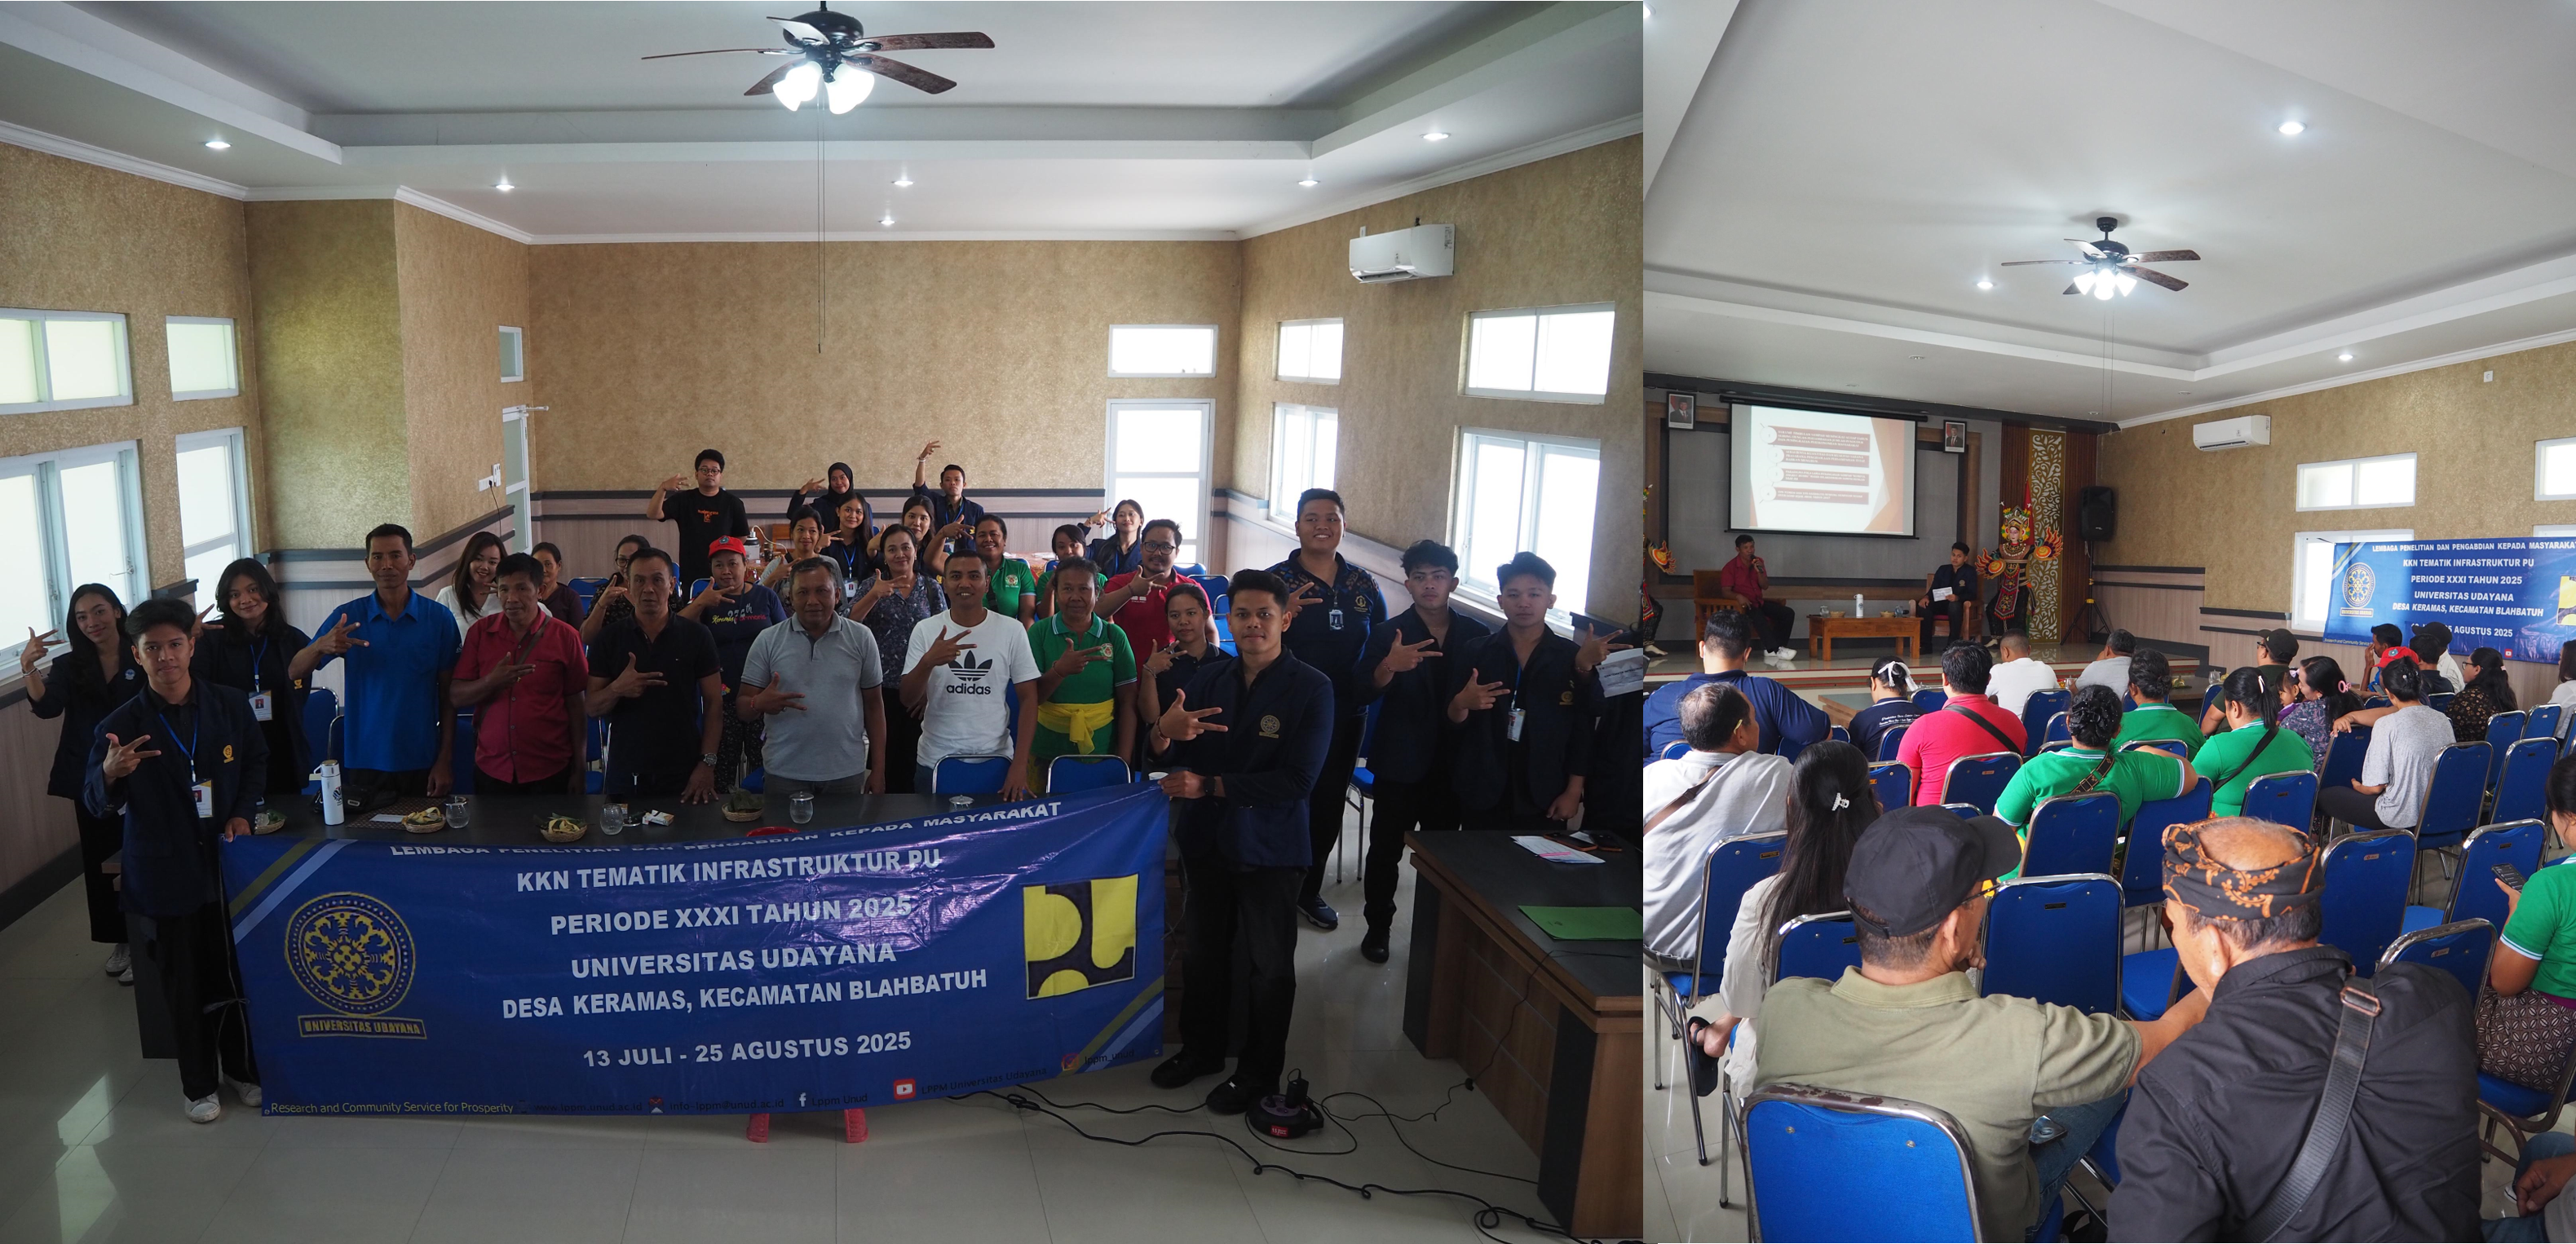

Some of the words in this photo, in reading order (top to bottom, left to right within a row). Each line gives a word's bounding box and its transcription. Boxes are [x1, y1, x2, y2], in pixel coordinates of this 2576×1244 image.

[2400, 544, 2434, 552] PENELITIAN
[2529, 541, 2576, 549] MASYARAKA
[2403, 558, 2418, 567] KKN
[2419, 558, 2451, 567] TEMATIK
[2453, 558, 2521, 567] INFRASTRUKTUR
[2522, 558, 2534, 567] PU
[2410, 576, 2445, 584] PERIODE
[2446, 576, 2466, 584] XXXI
[2468, 576, 2499, 585] TAHUN
[2500, 576, 2522, 585] 2025
[2414, 591, 2469, 600] UNIVERSITAS
[2471, 593, 2514, 602] UDAYANA
[2392, 602, 2410, 611] DESA
[2412, 603, 2447, 614] KERAMAS,
[2449, 605, 2494, 615] KECAMATAN
[2495, 607, 2544, 617] BLAHBATUH
[2454, 626, 2492, 636] AGUSTUS
[2494, 629, 2513, 637] 2025
[946, 683, 992, 695] adidas
[391, 845, 491, 856] LEMBAGA
[684, 834, 819, 850] PENGABDIAN
[829, 822, 913, 837] KEPADA
[923, 801, 1062, 827] MASYARAKAT
[517, 870, 569, 892] KKN
[577, 863, 686, 889] TEMATIK
[693, 850, 901, 881] INFRASTRUKTUR
[908, 849, 941, 871] PU
[550, 909, 669, 936] PERIODE
[675, 906, 739, 929] XXXI
[749, 900, 841, 925] TAHUN
[847, 894, 913, 920] 2025
[571, 951, 754, 978] UNIVERSITAS
[761, 942, 896, 968] UDAYANA
[503, 997, 563, 1019] DESA
[573, 989, 693, 1015] KERAMAS,
[700, 982, 842, 1009] KECAMATAN
[849, 968, 988, 1001] BLAHBATUH
[304, 1020, 372, 1033] UNIVERSITAS
[582, 1049, 611, 1067] 13
[618, 1046, 673, 1065] JULI
[695, 1043, 723, 1063] 25
[731, 1037, 850, 1061] AGUSTUS
[856, 1030, 912, 1055] 2025
[1085, 1049, 1135, 1065] lppm_unud
[921, 1083, 948, 1095] LPPM
[950, 1074, 1003, 1090] Universitas
[1006, 1067, 1048, 1083] Udayana
[669, 1099, 784, 1112] info-lppm@unud.ac.id
[811, 1097, 840, 1107] Lppm
[842, 1093, 868, 1105] Unud
[271, 1102, 317, 1114] Research
[320, 1102, 340, 1114] and
[343, 1101, 401, 1116] Community
[404, 1101, 443, 1114] Service
[446, 1101, 458, 1114] for
[462, 1101, 514, 1116] Prosperity
